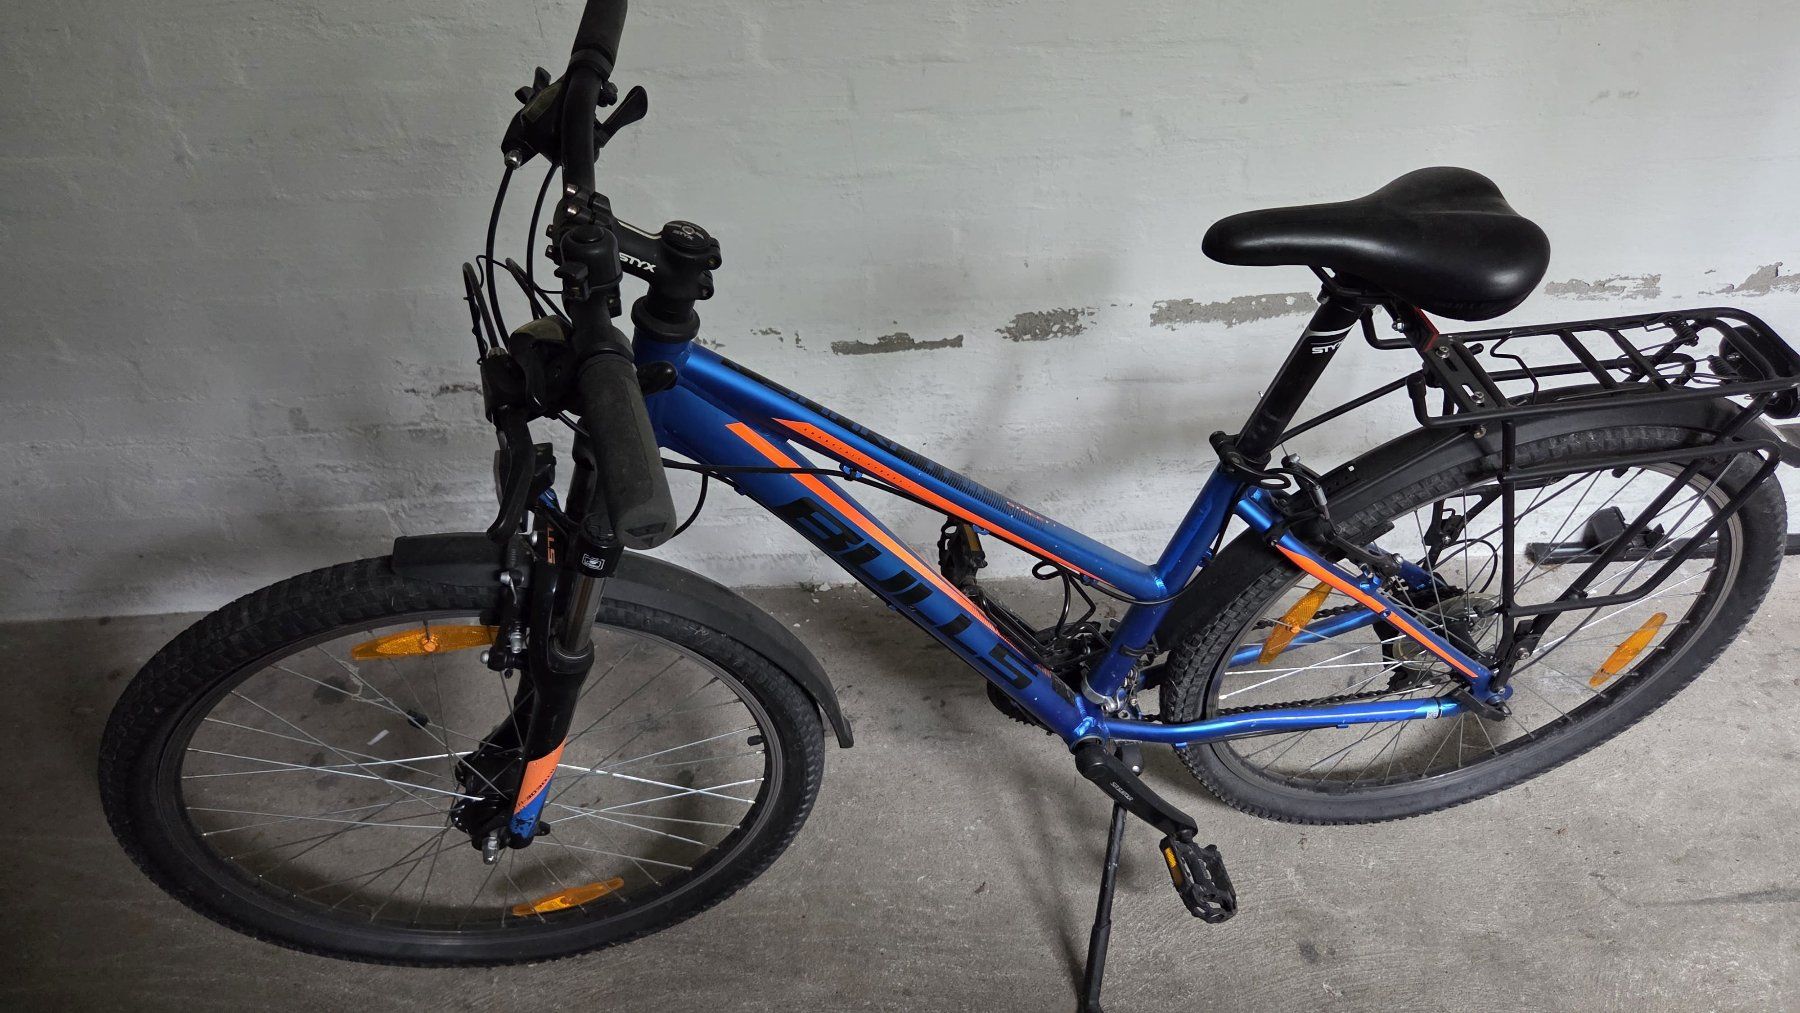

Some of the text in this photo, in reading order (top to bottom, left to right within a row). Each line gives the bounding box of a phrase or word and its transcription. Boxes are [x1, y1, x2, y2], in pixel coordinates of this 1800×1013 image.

[618, 251, 657, 273] STYX
[546, 526, 558, 564] LLS
[777, 496, 1039, 690] BULLS
